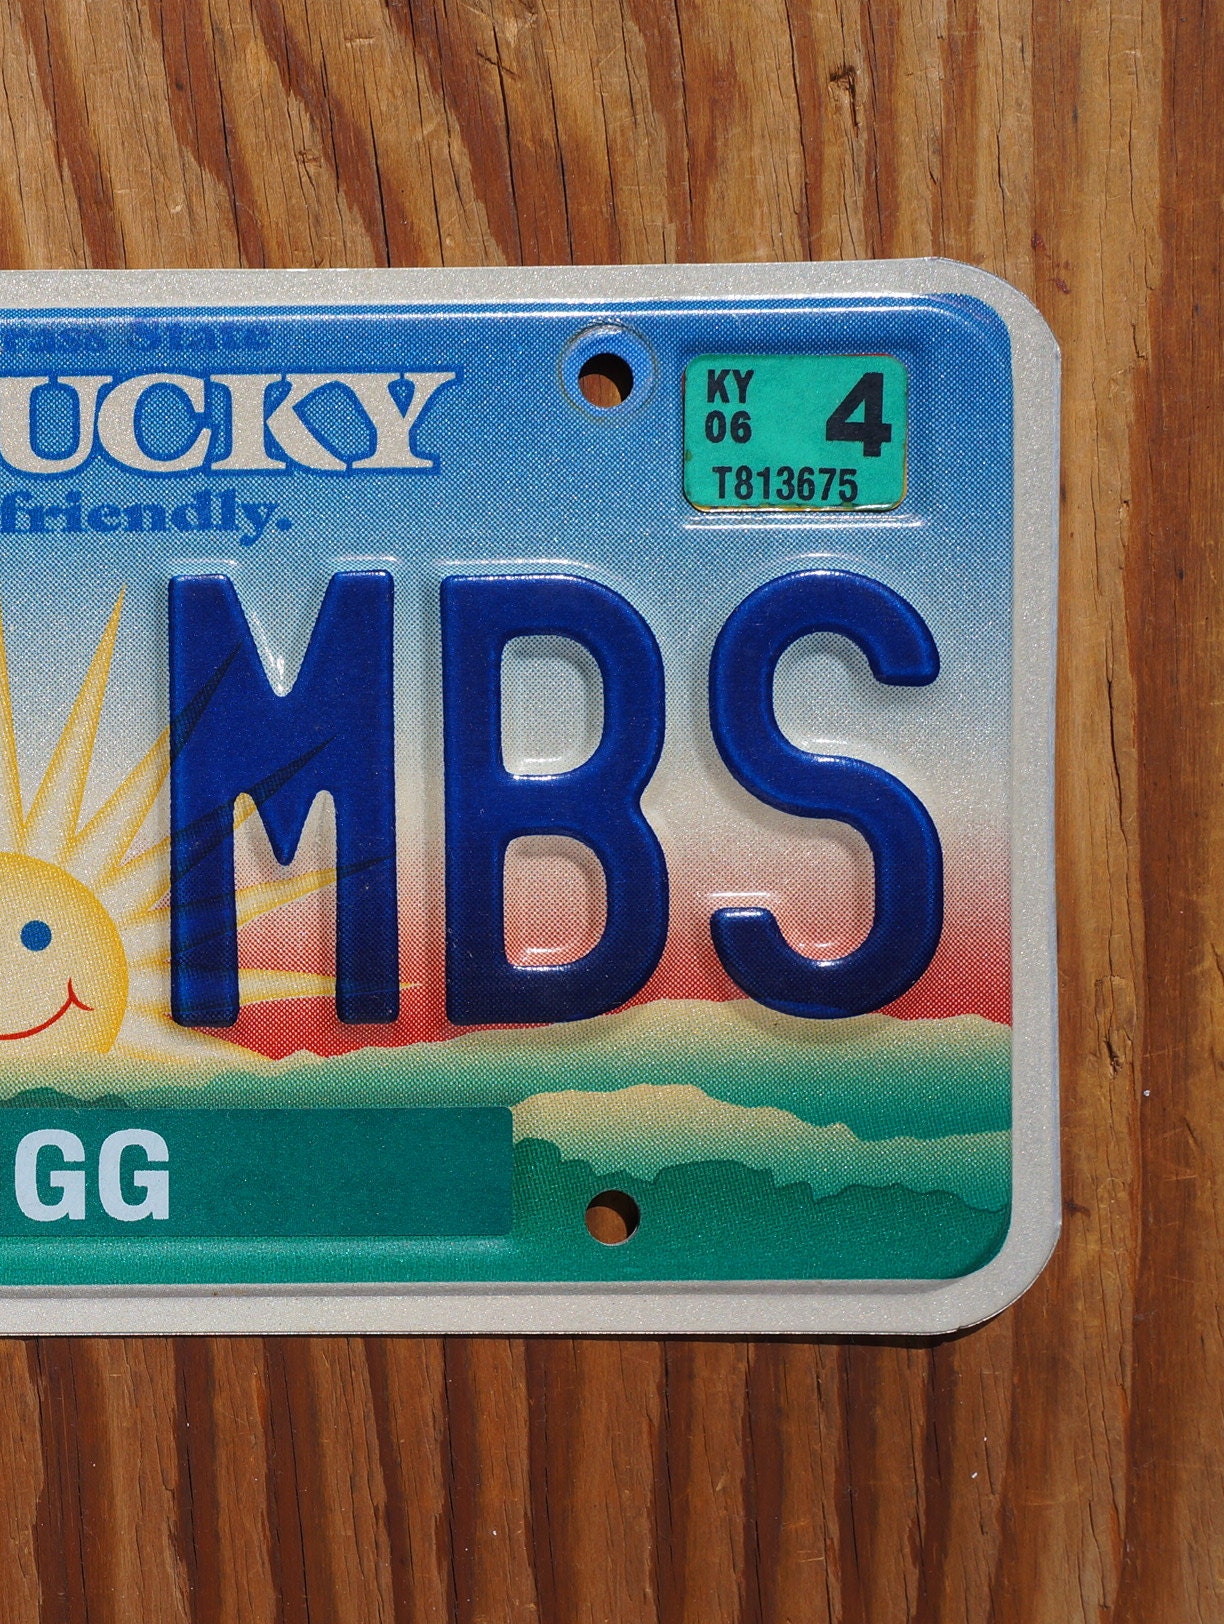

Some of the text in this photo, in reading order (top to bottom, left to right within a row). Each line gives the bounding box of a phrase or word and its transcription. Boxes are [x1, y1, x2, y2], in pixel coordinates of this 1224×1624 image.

[130, 316, 272, 352] State
[706, 369, 755, 403] KY
[704, 410, 753, 444] 06
[826, 371, 893, 457] 4
[711, 465, 858, 503] T813675
[169, 569, 944, 1028] MBS
